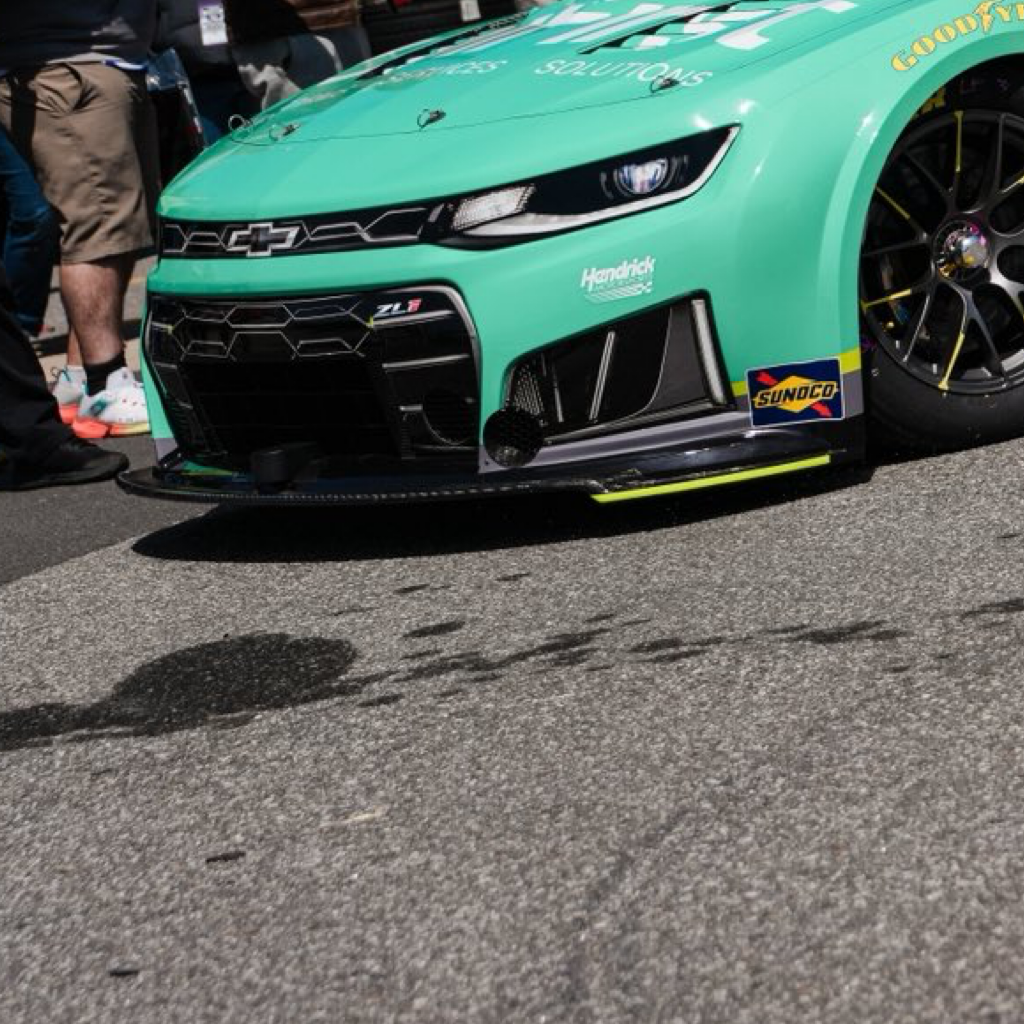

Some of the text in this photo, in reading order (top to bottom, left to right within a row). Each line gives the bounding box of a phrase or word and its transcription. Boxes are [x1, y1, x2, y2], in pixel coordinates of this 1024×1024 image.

[534, 59, 713, 87] SOLUTIONS
[580, 255, 656, 292] Hendrick
[374, 297, 422, 317] ZL1
[757, 382, 836, 407] SUNOCO
